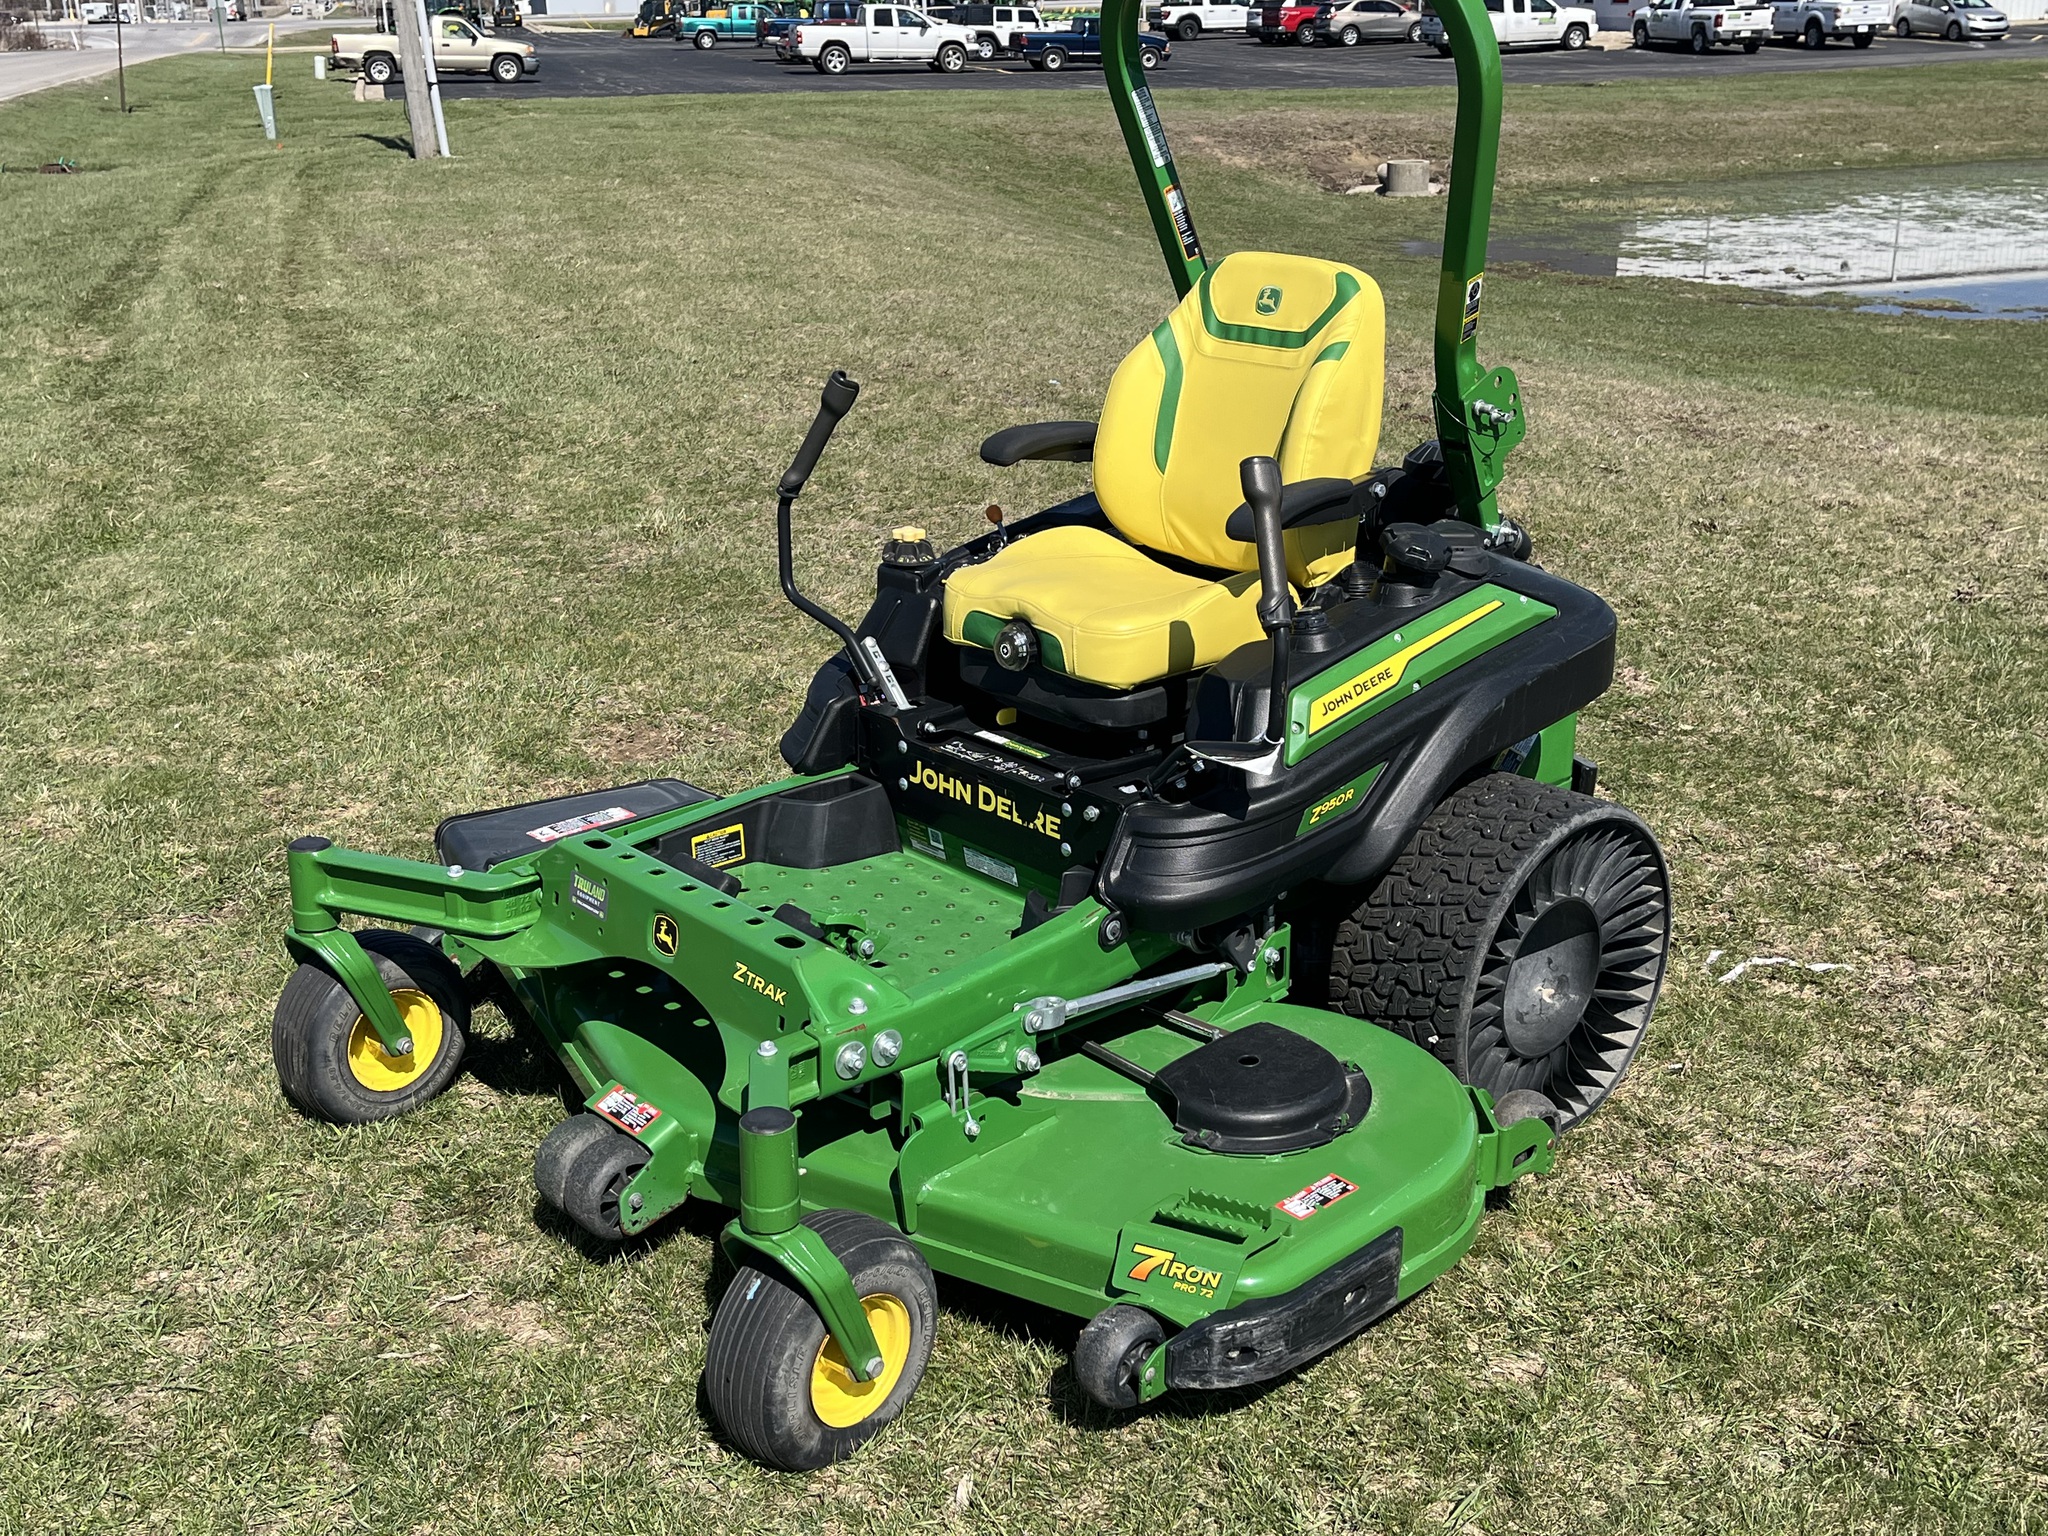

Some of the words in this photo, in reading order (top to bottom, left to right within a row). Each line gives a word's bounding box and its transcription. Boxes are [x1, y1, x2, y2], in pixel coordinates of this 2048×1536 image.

[1322, 690, 1353, 717] JOHN
[1353, 667, 1393, 697] DEERE
[909, 760, 972, 805] JOHN
[1309, 788, 1354, 824] Z950R
[573, 874, 606, 902] TRULAND
[1172, 1281, 1197, 1294] PRO
[1199, 1287, 1215, 1299] 72
